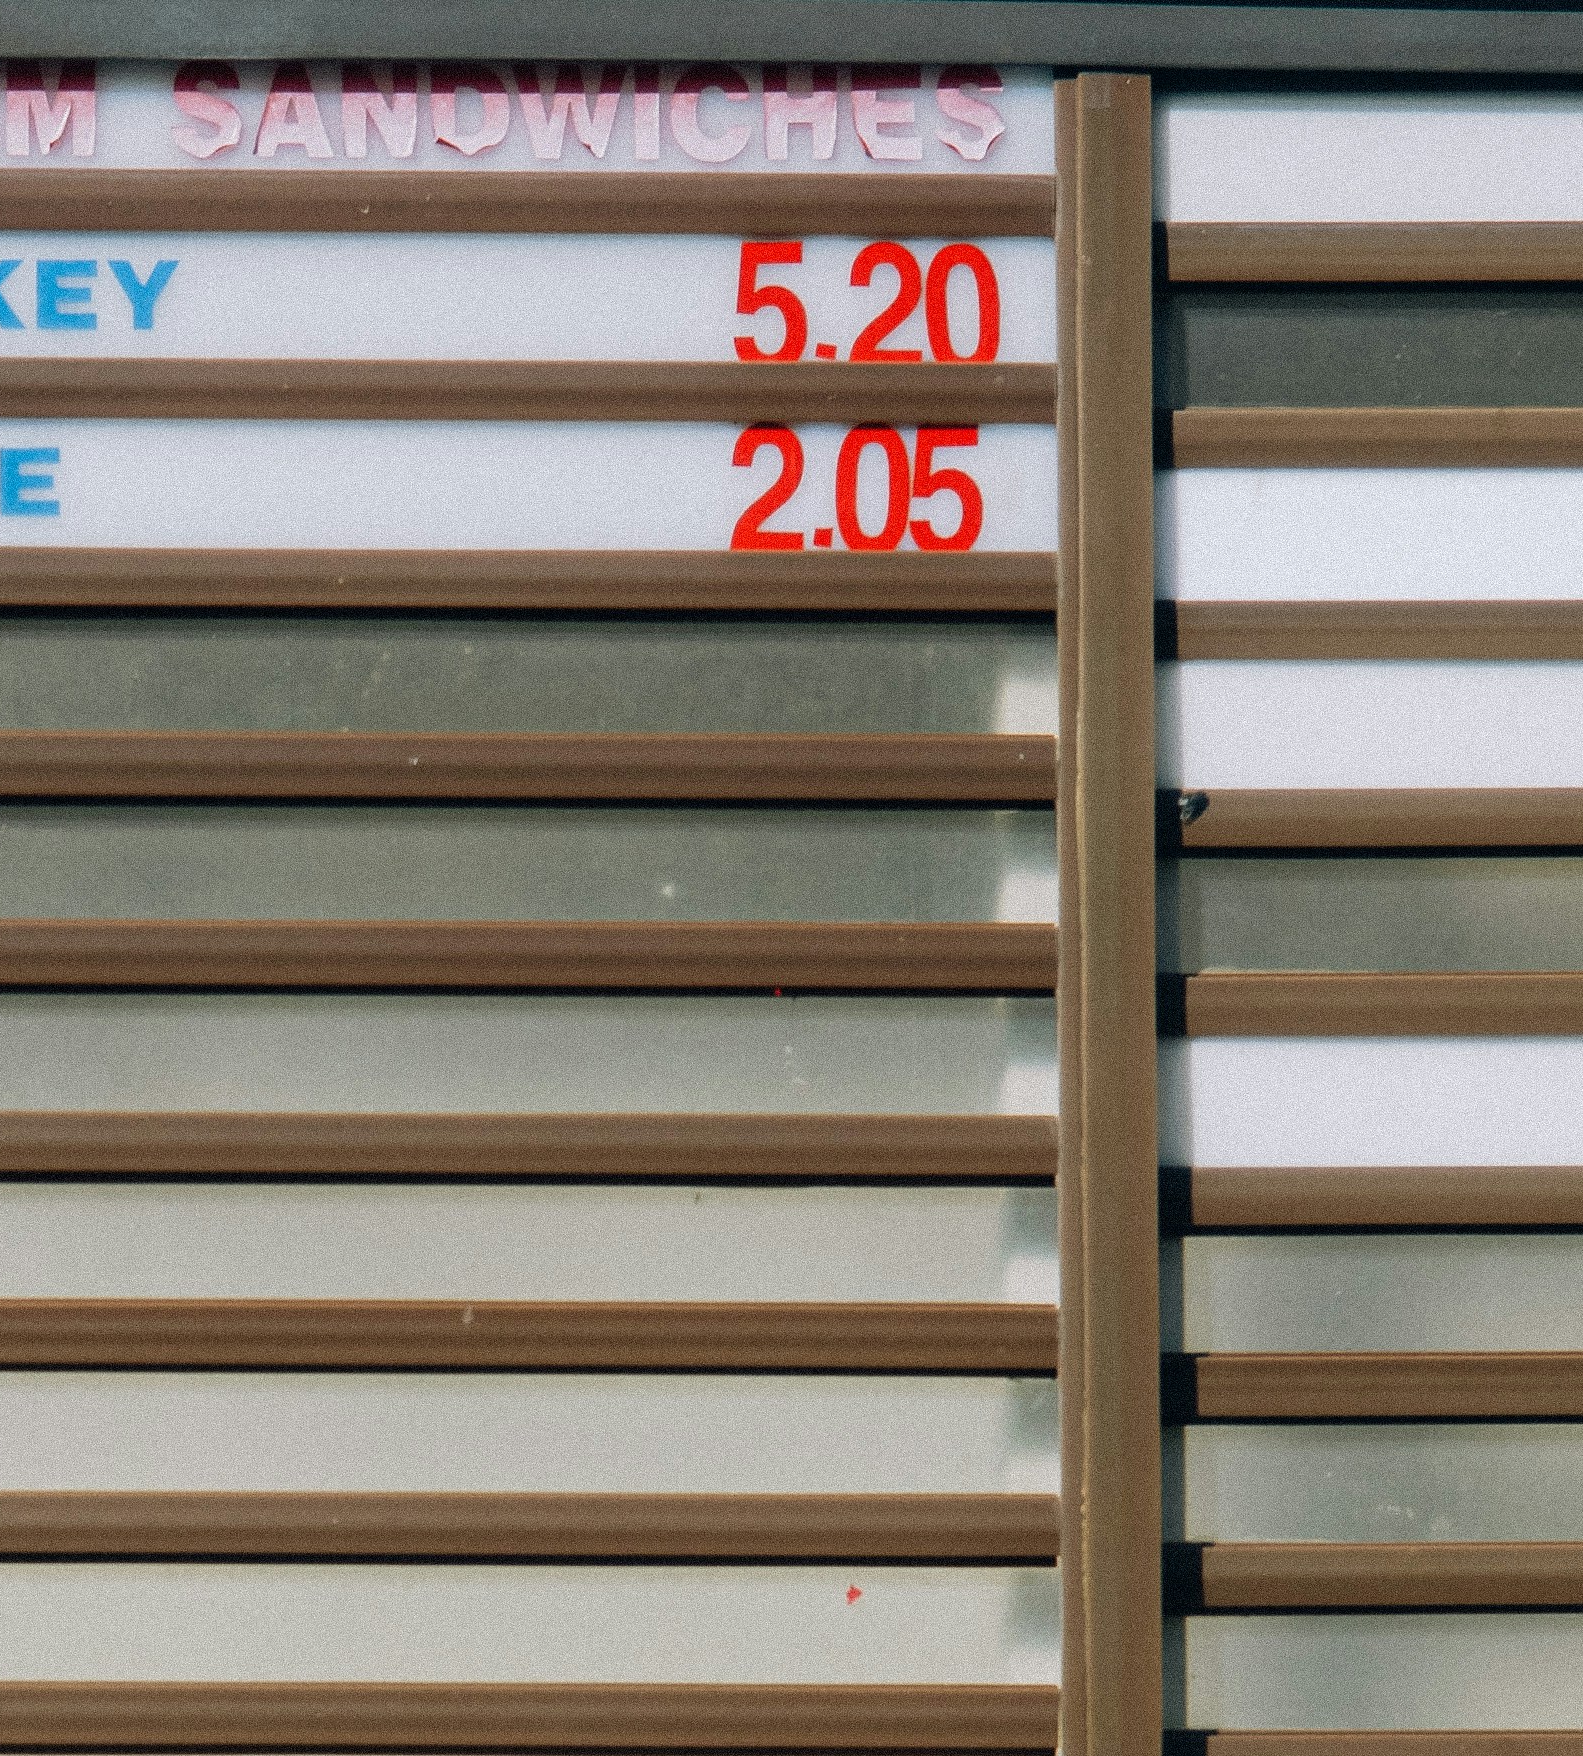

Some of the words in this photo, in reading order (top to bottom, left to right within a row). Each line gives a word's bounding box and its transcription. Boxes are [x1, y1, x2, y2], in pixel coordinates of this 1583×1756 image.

[171, 62, 1005, 163] SANDWICHES
[734, 241, 1001, 363] 5.20
[730, 426, 984, 552] 2.05
